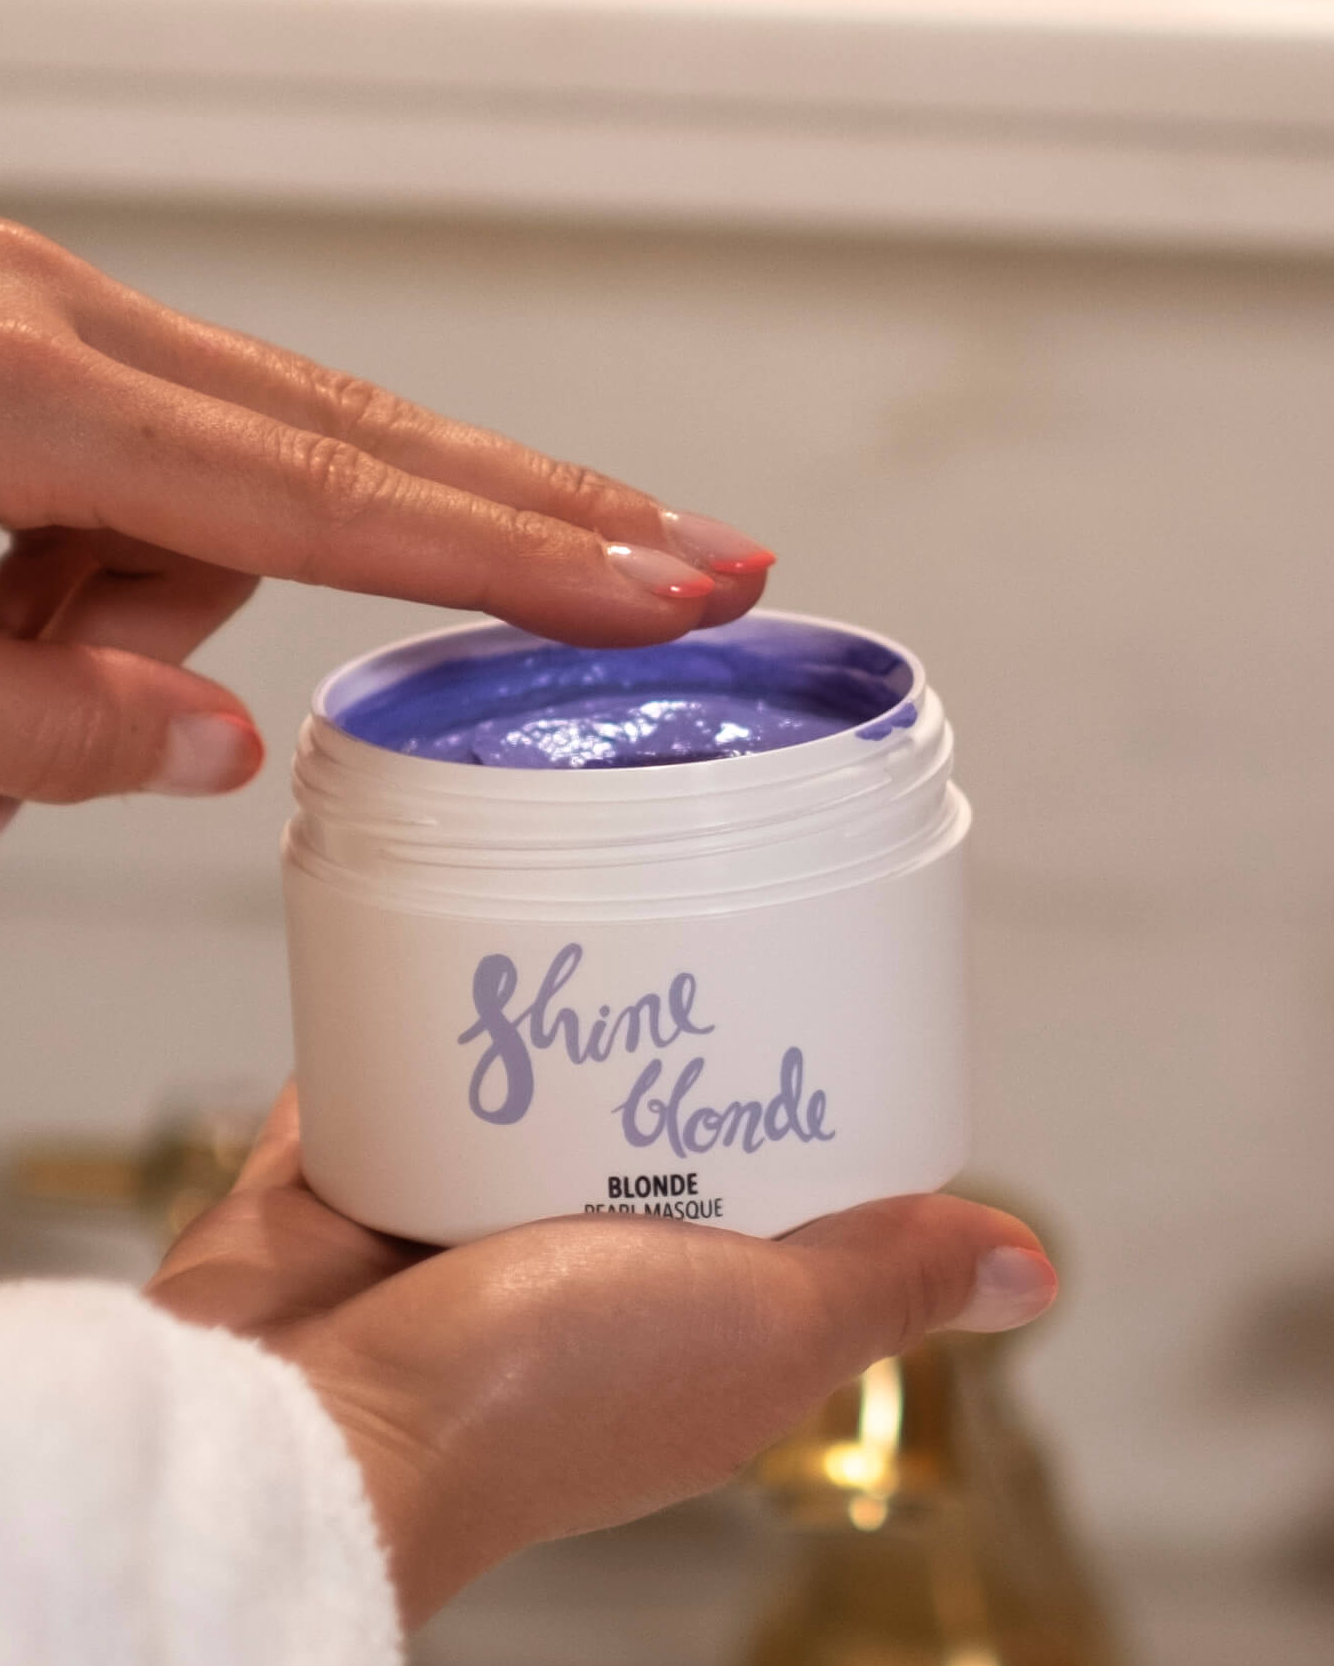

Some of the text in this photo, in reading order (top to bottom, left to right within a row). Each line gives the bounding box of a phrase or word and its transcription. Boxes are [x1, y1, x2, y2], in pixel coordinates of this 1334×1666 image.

[457, 943, 715, 1125] Shine
[611, 1046, 836, 1159] blonde
[608, 1173, 698, 1199] BLONDE
[644, 1198, 723, 1220] MASQUE
